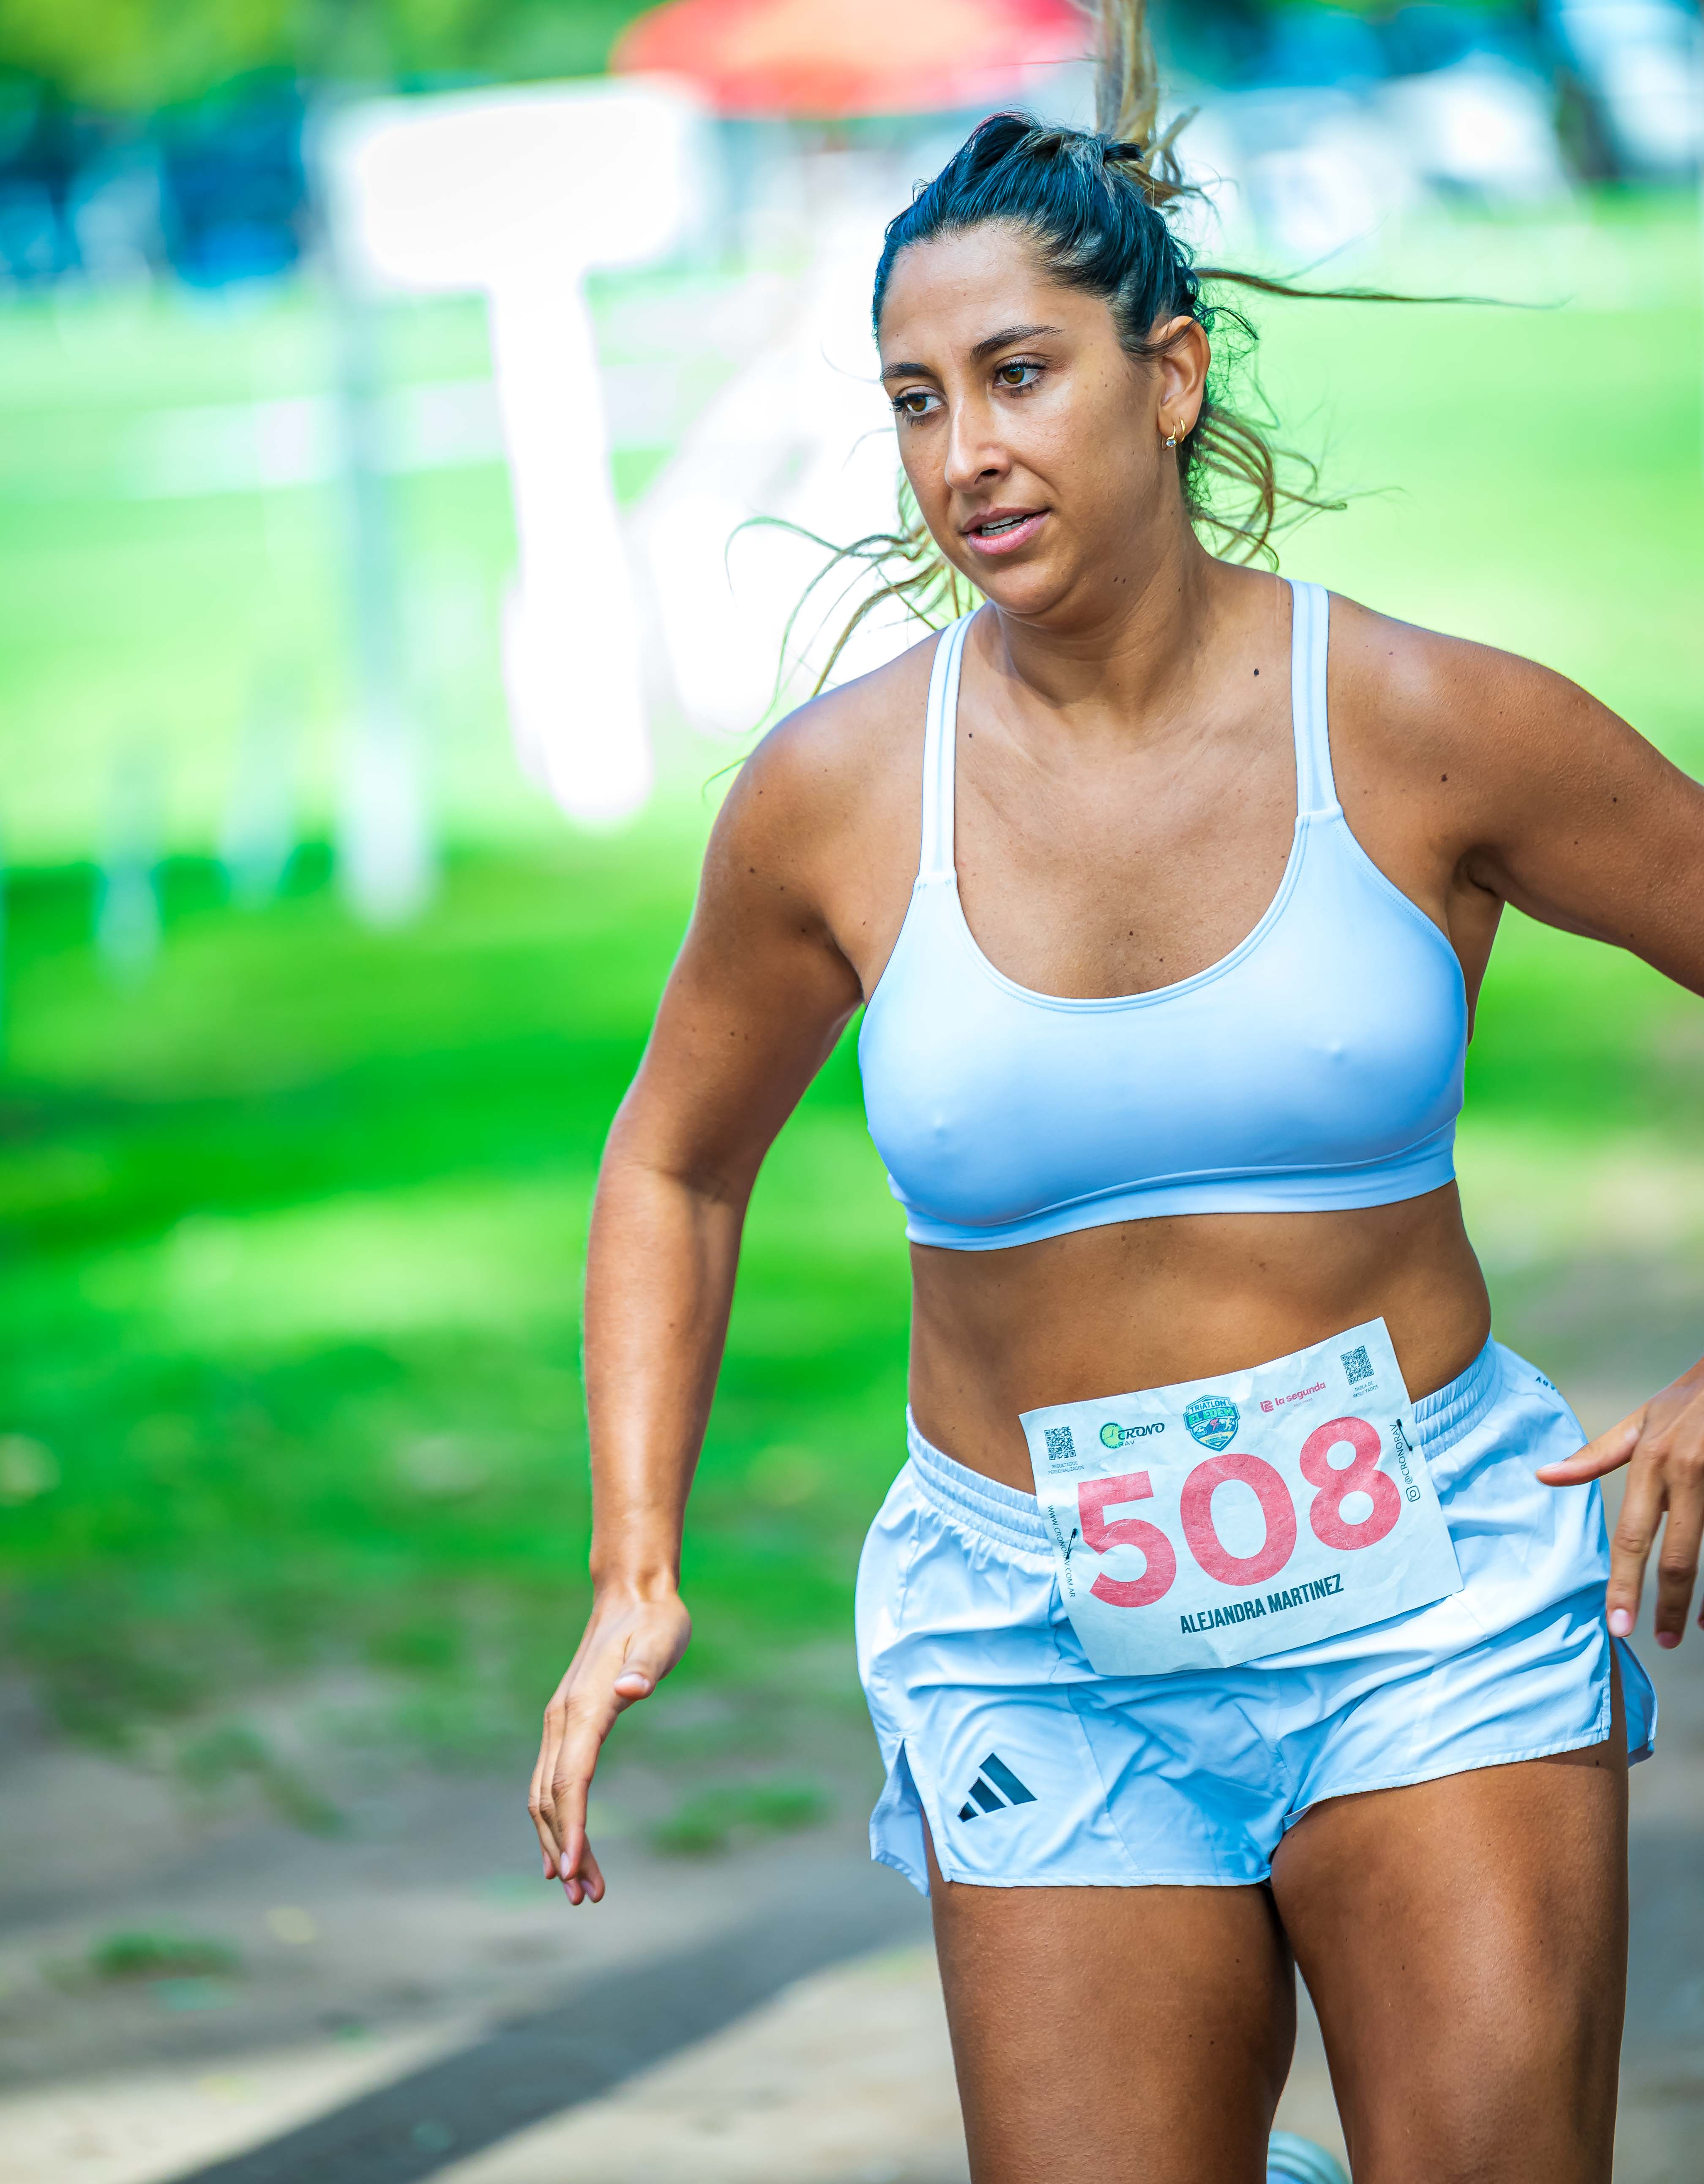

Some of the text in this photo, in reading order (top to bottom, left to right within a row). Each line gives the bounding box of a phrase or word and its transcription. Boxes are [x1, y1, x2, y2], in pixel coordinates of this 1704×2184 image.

[1275, 1397, 1285, 1406] la
[1286, 1382, 1326, 1402] segunda
[1190, 1400, 1226, 1413] TRIATLON
[1188, 1414, 1203, 1426] EL
[1118, 1423, 1165, 1440] CRONO
[1118, 1439, 1135, 1448] RAV
[1390, 1424, 1413, 1484] @CRONORAV
[1048, 1465, 1085, 1475] PERSONALIZADOS
[1051, 1461, 1078, 1469] RESULTADOS
[1078, 1416, 1401, 1607] 508
[1180, 1573, 1344, 1634] ALEJANDRA MARTINEZ
